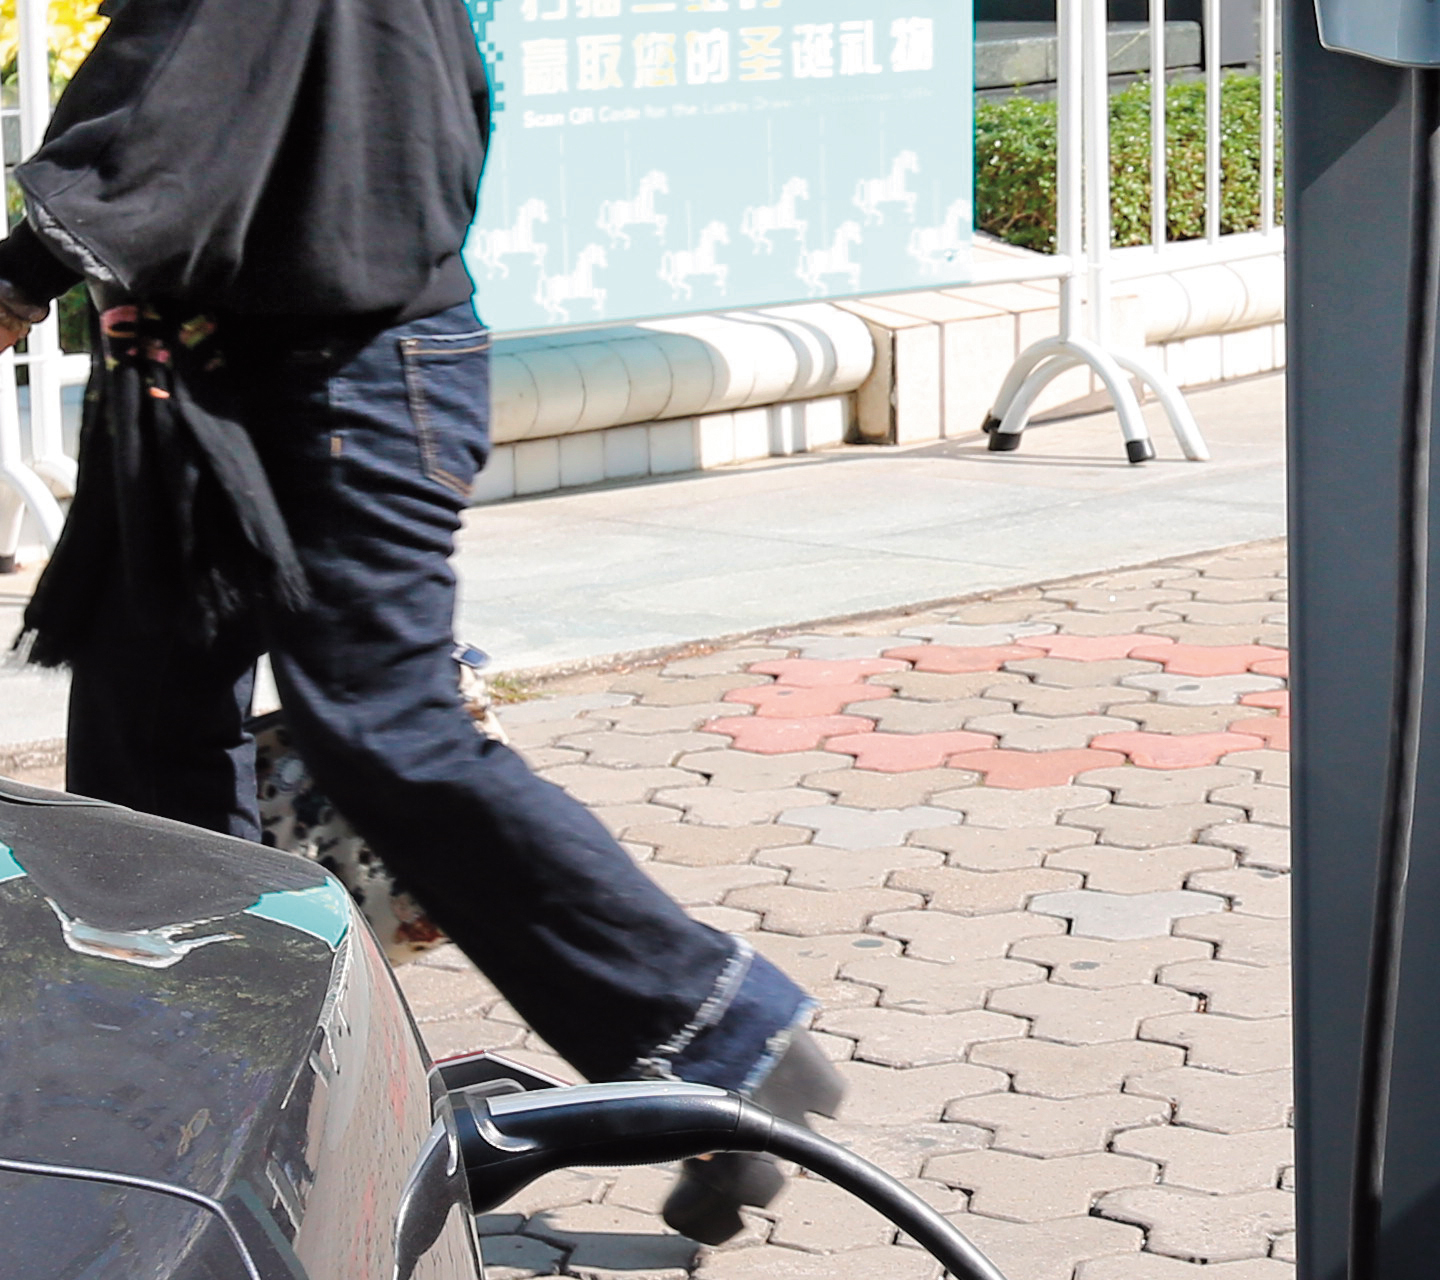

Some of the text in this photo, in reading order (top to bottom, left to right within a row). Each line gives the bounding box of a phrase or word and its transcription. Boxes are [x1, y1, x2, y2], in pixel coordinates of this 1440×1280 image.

[521, 16, 935, 96] 赢取您的圣诞礼物
[523, 110, 565, 128] Scan
[569, 107, 594, 125] QR
[598, 106, 641, 123] Code
